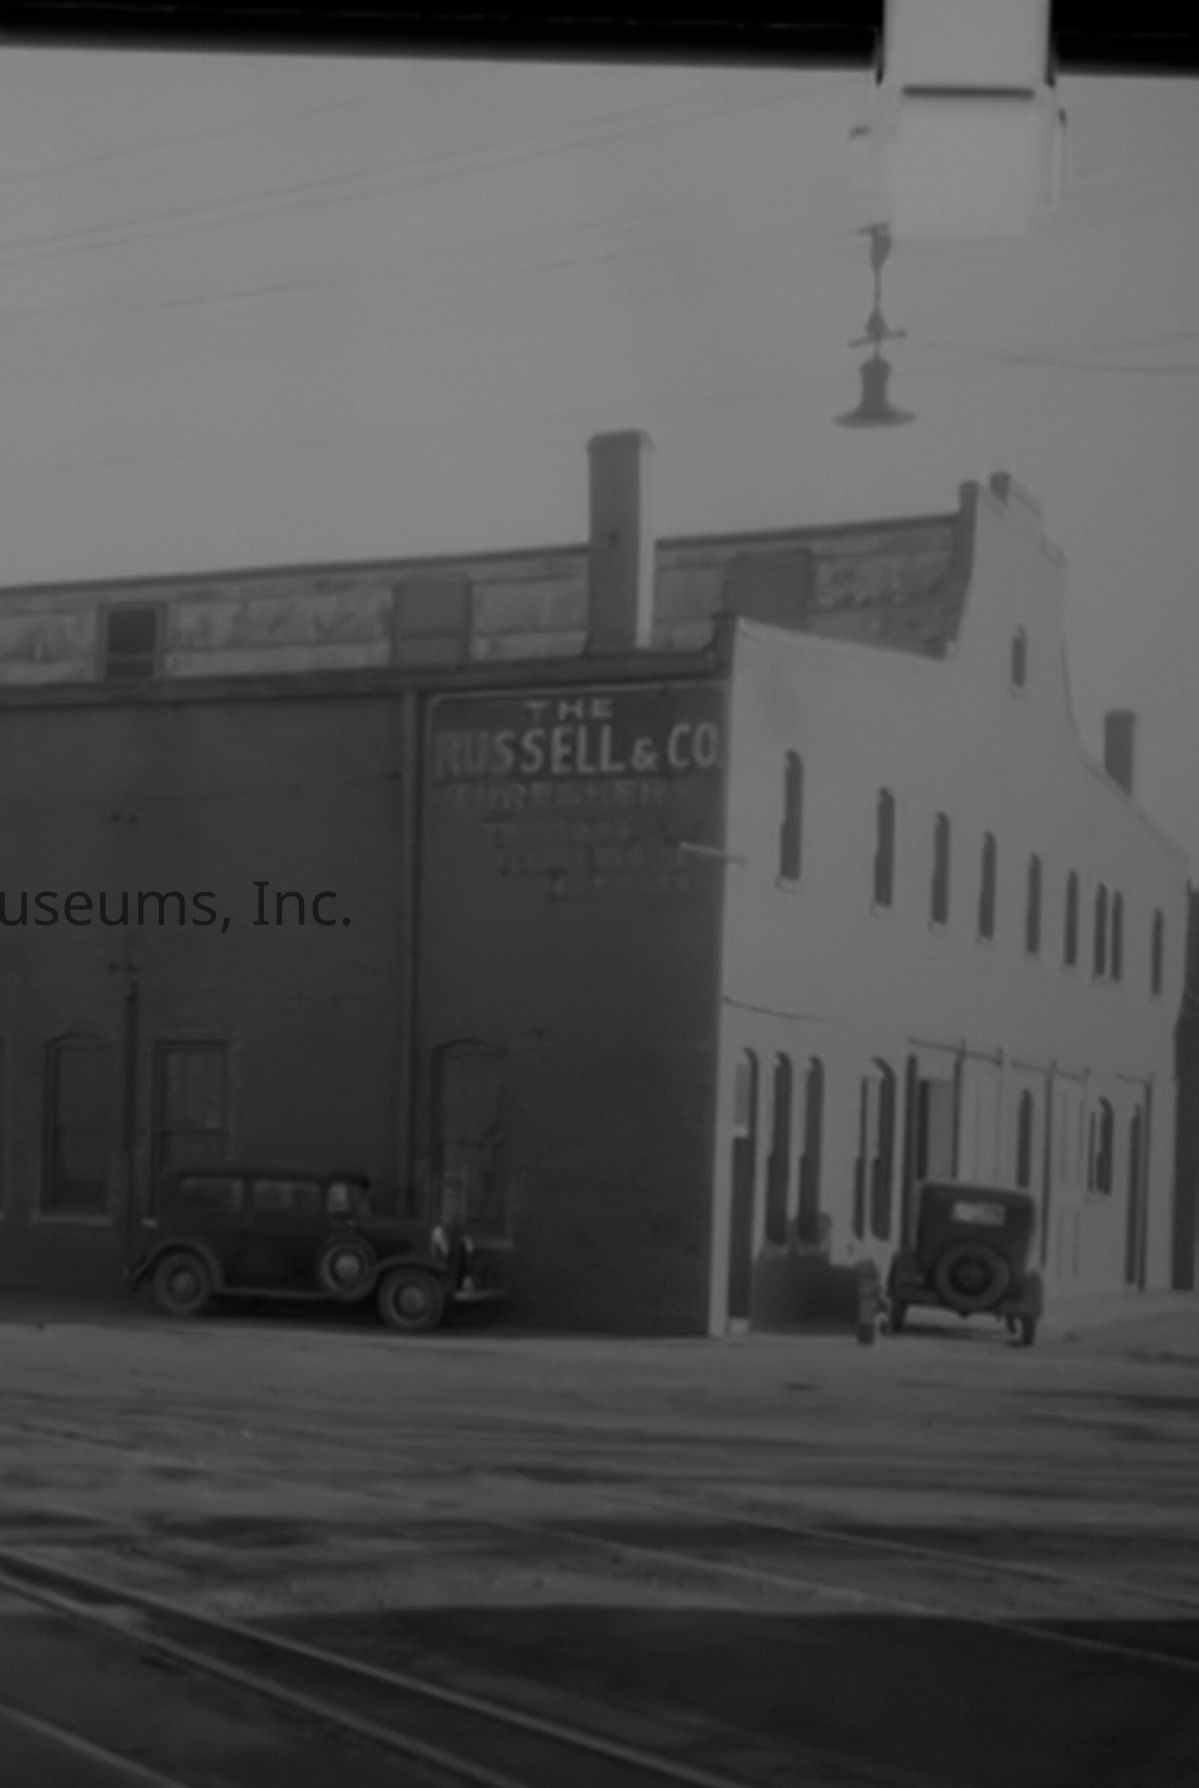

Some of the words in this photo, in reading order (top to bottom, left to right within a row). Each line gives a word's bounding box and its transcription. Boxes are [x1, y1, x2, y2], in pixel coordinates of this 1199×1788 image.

[523, 697, 615, 721] THE
[436, 725, 626, 777] RUSSELL
[632, 738, 659, 771] &
